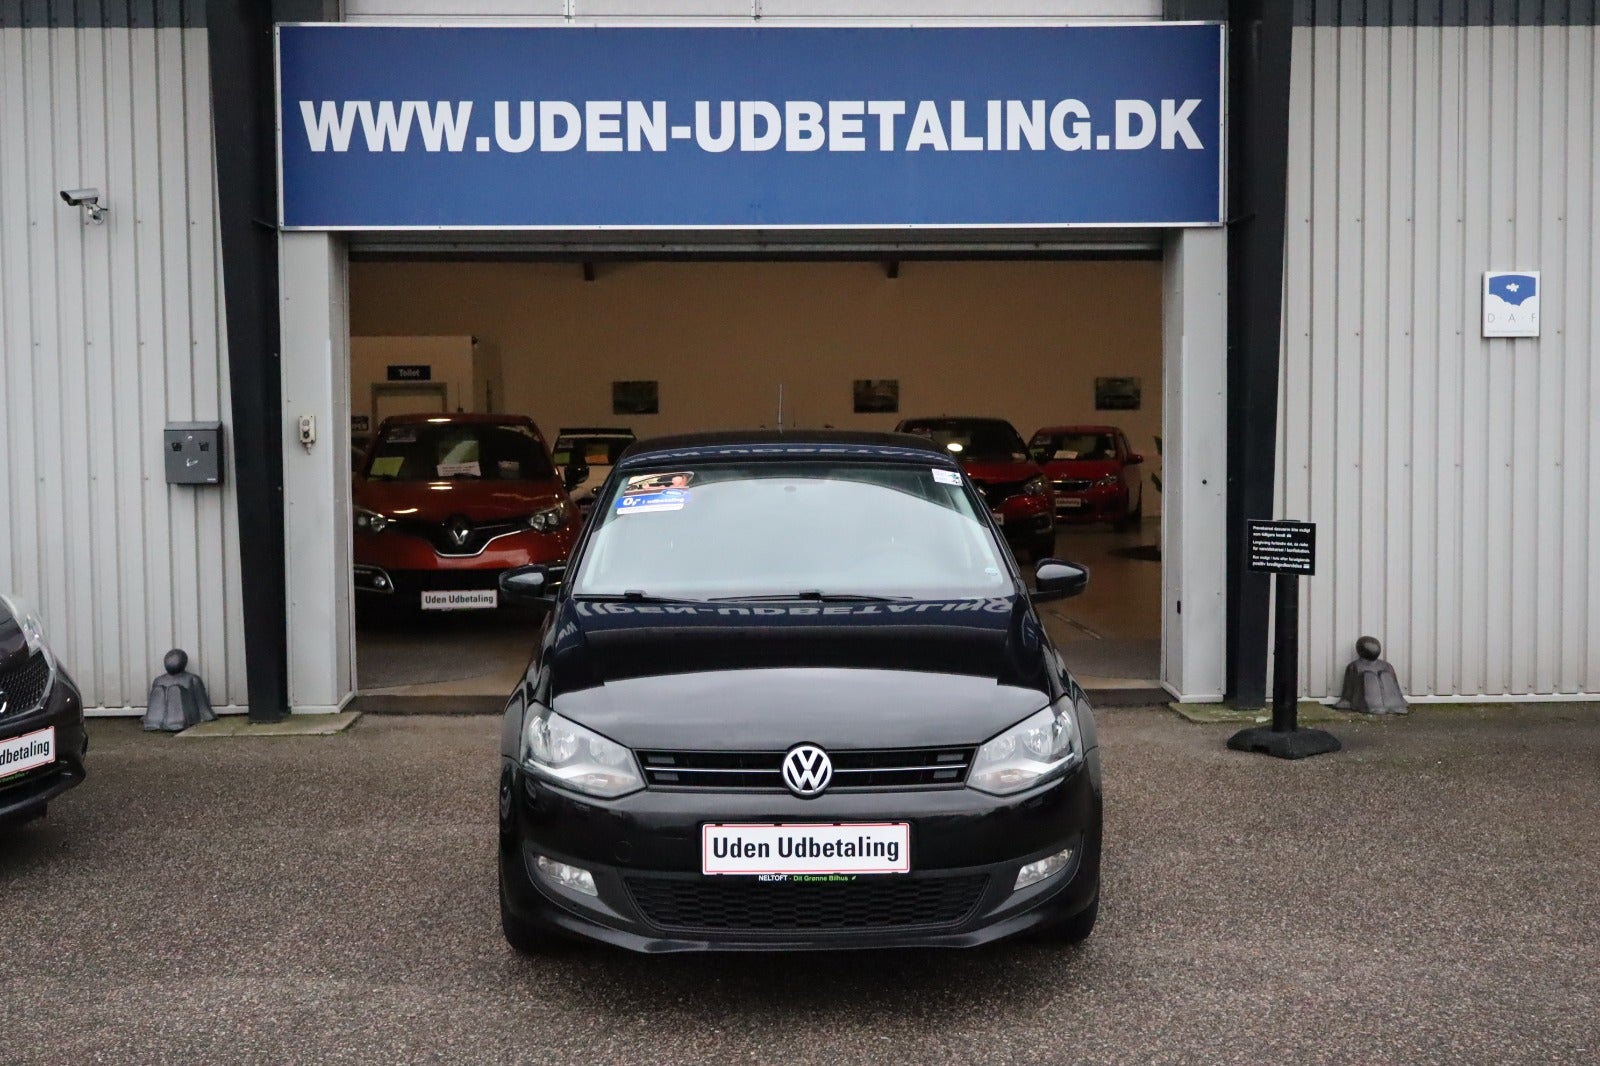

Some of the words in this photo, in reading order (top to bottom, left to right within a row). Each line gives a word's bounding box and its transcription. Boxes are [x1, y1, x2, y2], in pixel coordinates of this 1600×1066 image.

[299, 98, 1204, 153] WWW.UDEN-UDBETALING.DK
[425, 595, 447, 604] Uden
[448, 594, 494, 604] Udbetaling
[0, 740, 50, 765] dbetaling
[713, 836, 770, 858] Uden
[777, 836, 900, 862] Udbetaling
